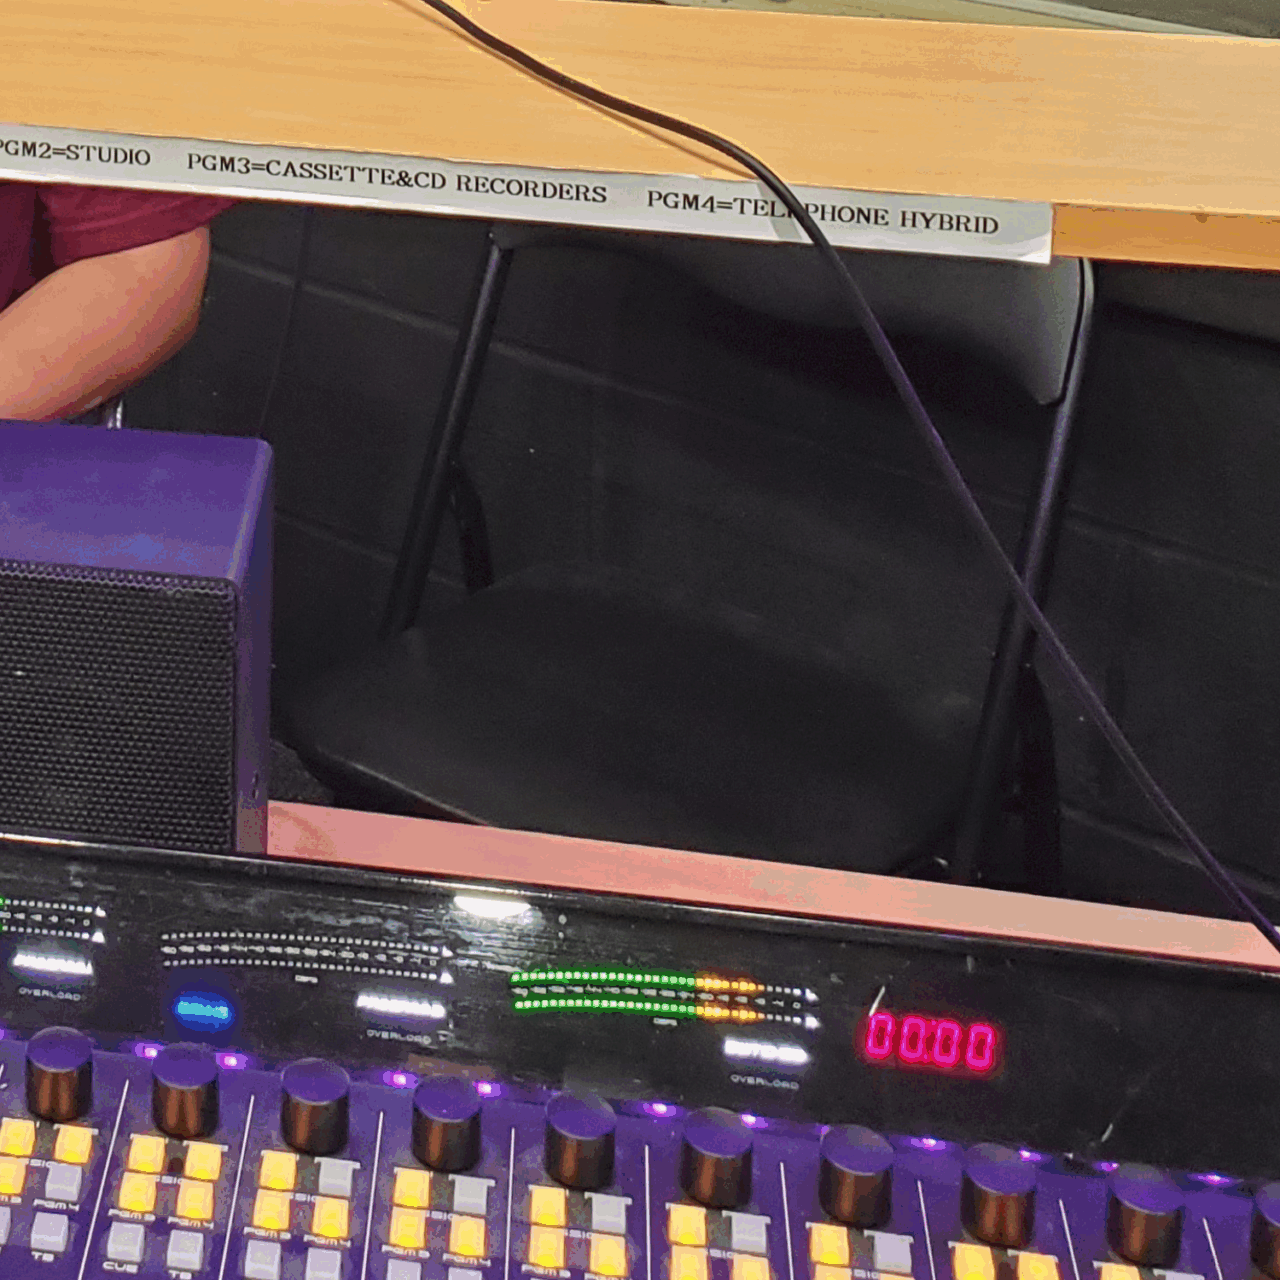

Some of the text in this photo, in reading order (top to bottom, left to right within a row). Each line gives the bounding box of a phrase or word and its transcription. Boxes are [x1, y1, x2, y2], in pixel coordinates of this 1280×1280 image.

[187, 152, 447, 190] PGM3=CASSETTE&CD
[456, 174, 608, 204] RECORDERS
[647, 190, 890, 227] PGM4=TELPHONE
[900, 209, 999, 235] HYBRID
[18, 986, 81, 1001] OVERLOAD
[730, 1074, 800, 1090] OVERLOAD
[102, 1261, 139, 1273] CUE
